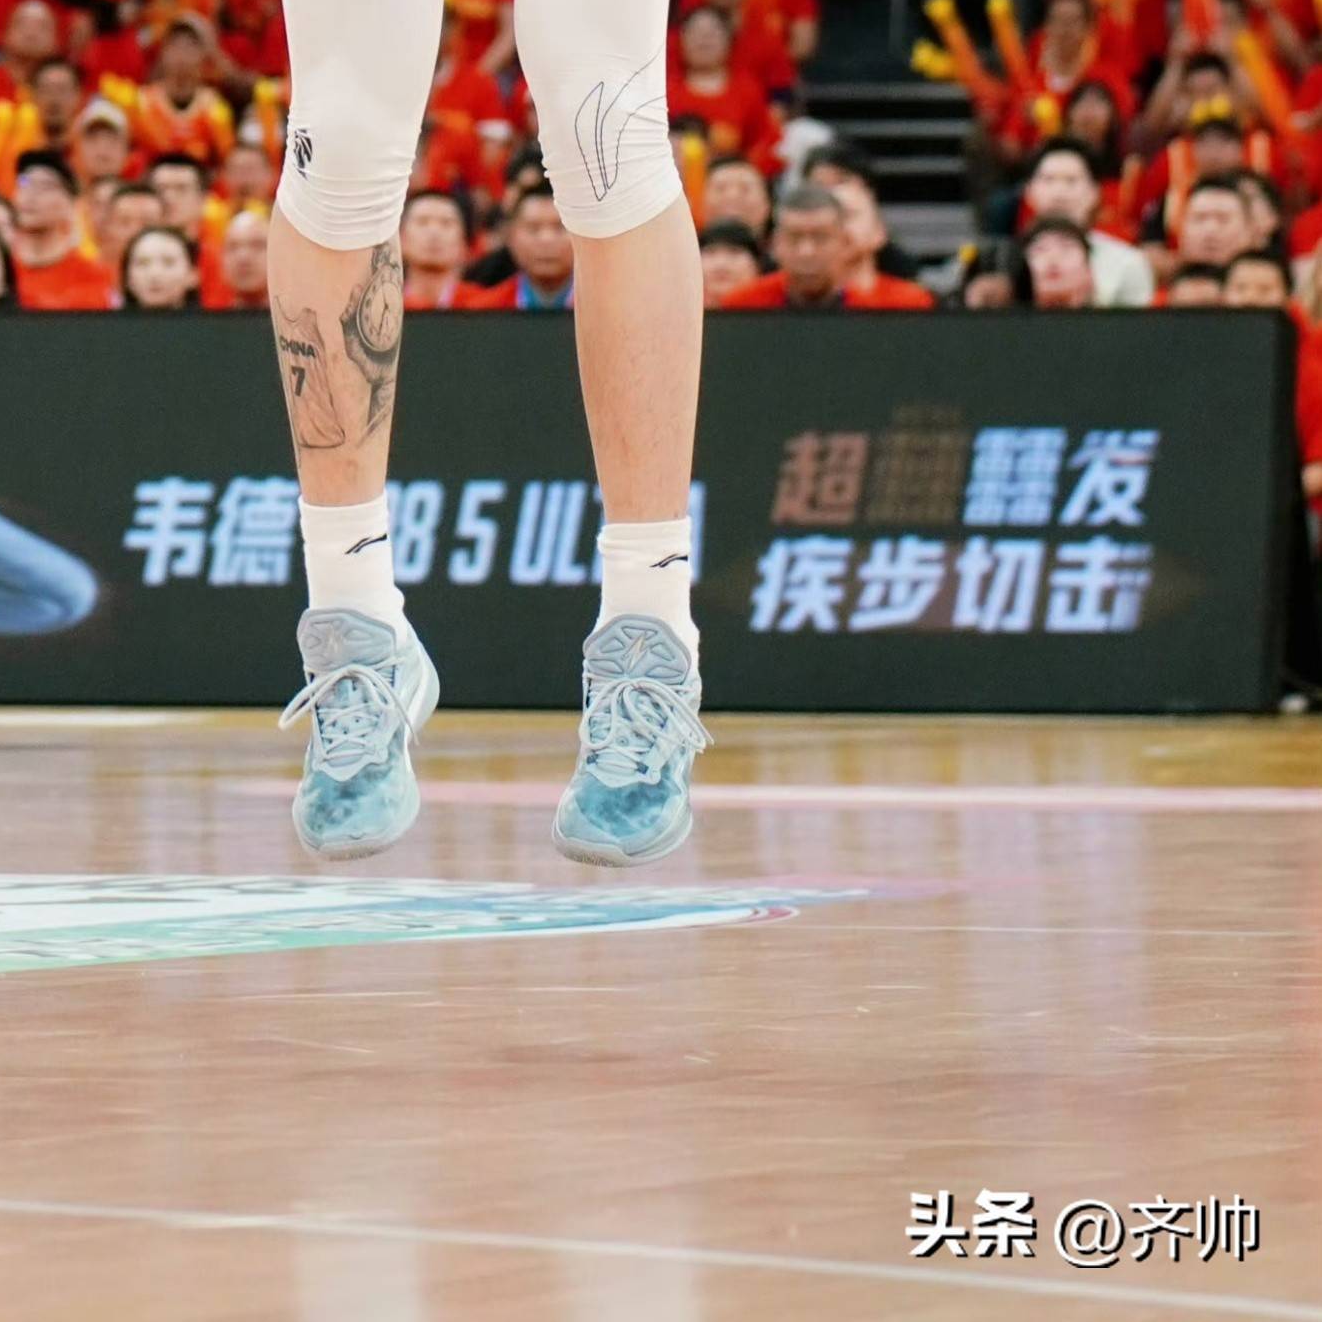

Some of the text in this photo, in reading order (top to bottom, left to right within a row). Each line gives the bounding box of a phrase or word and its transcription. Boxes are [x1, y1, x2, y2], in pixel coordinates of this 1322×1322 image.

[291, 365, 306, 397] 7
[447, 481, 506, 585] 5
[750, 535, 1153, 634] 疾步切击
